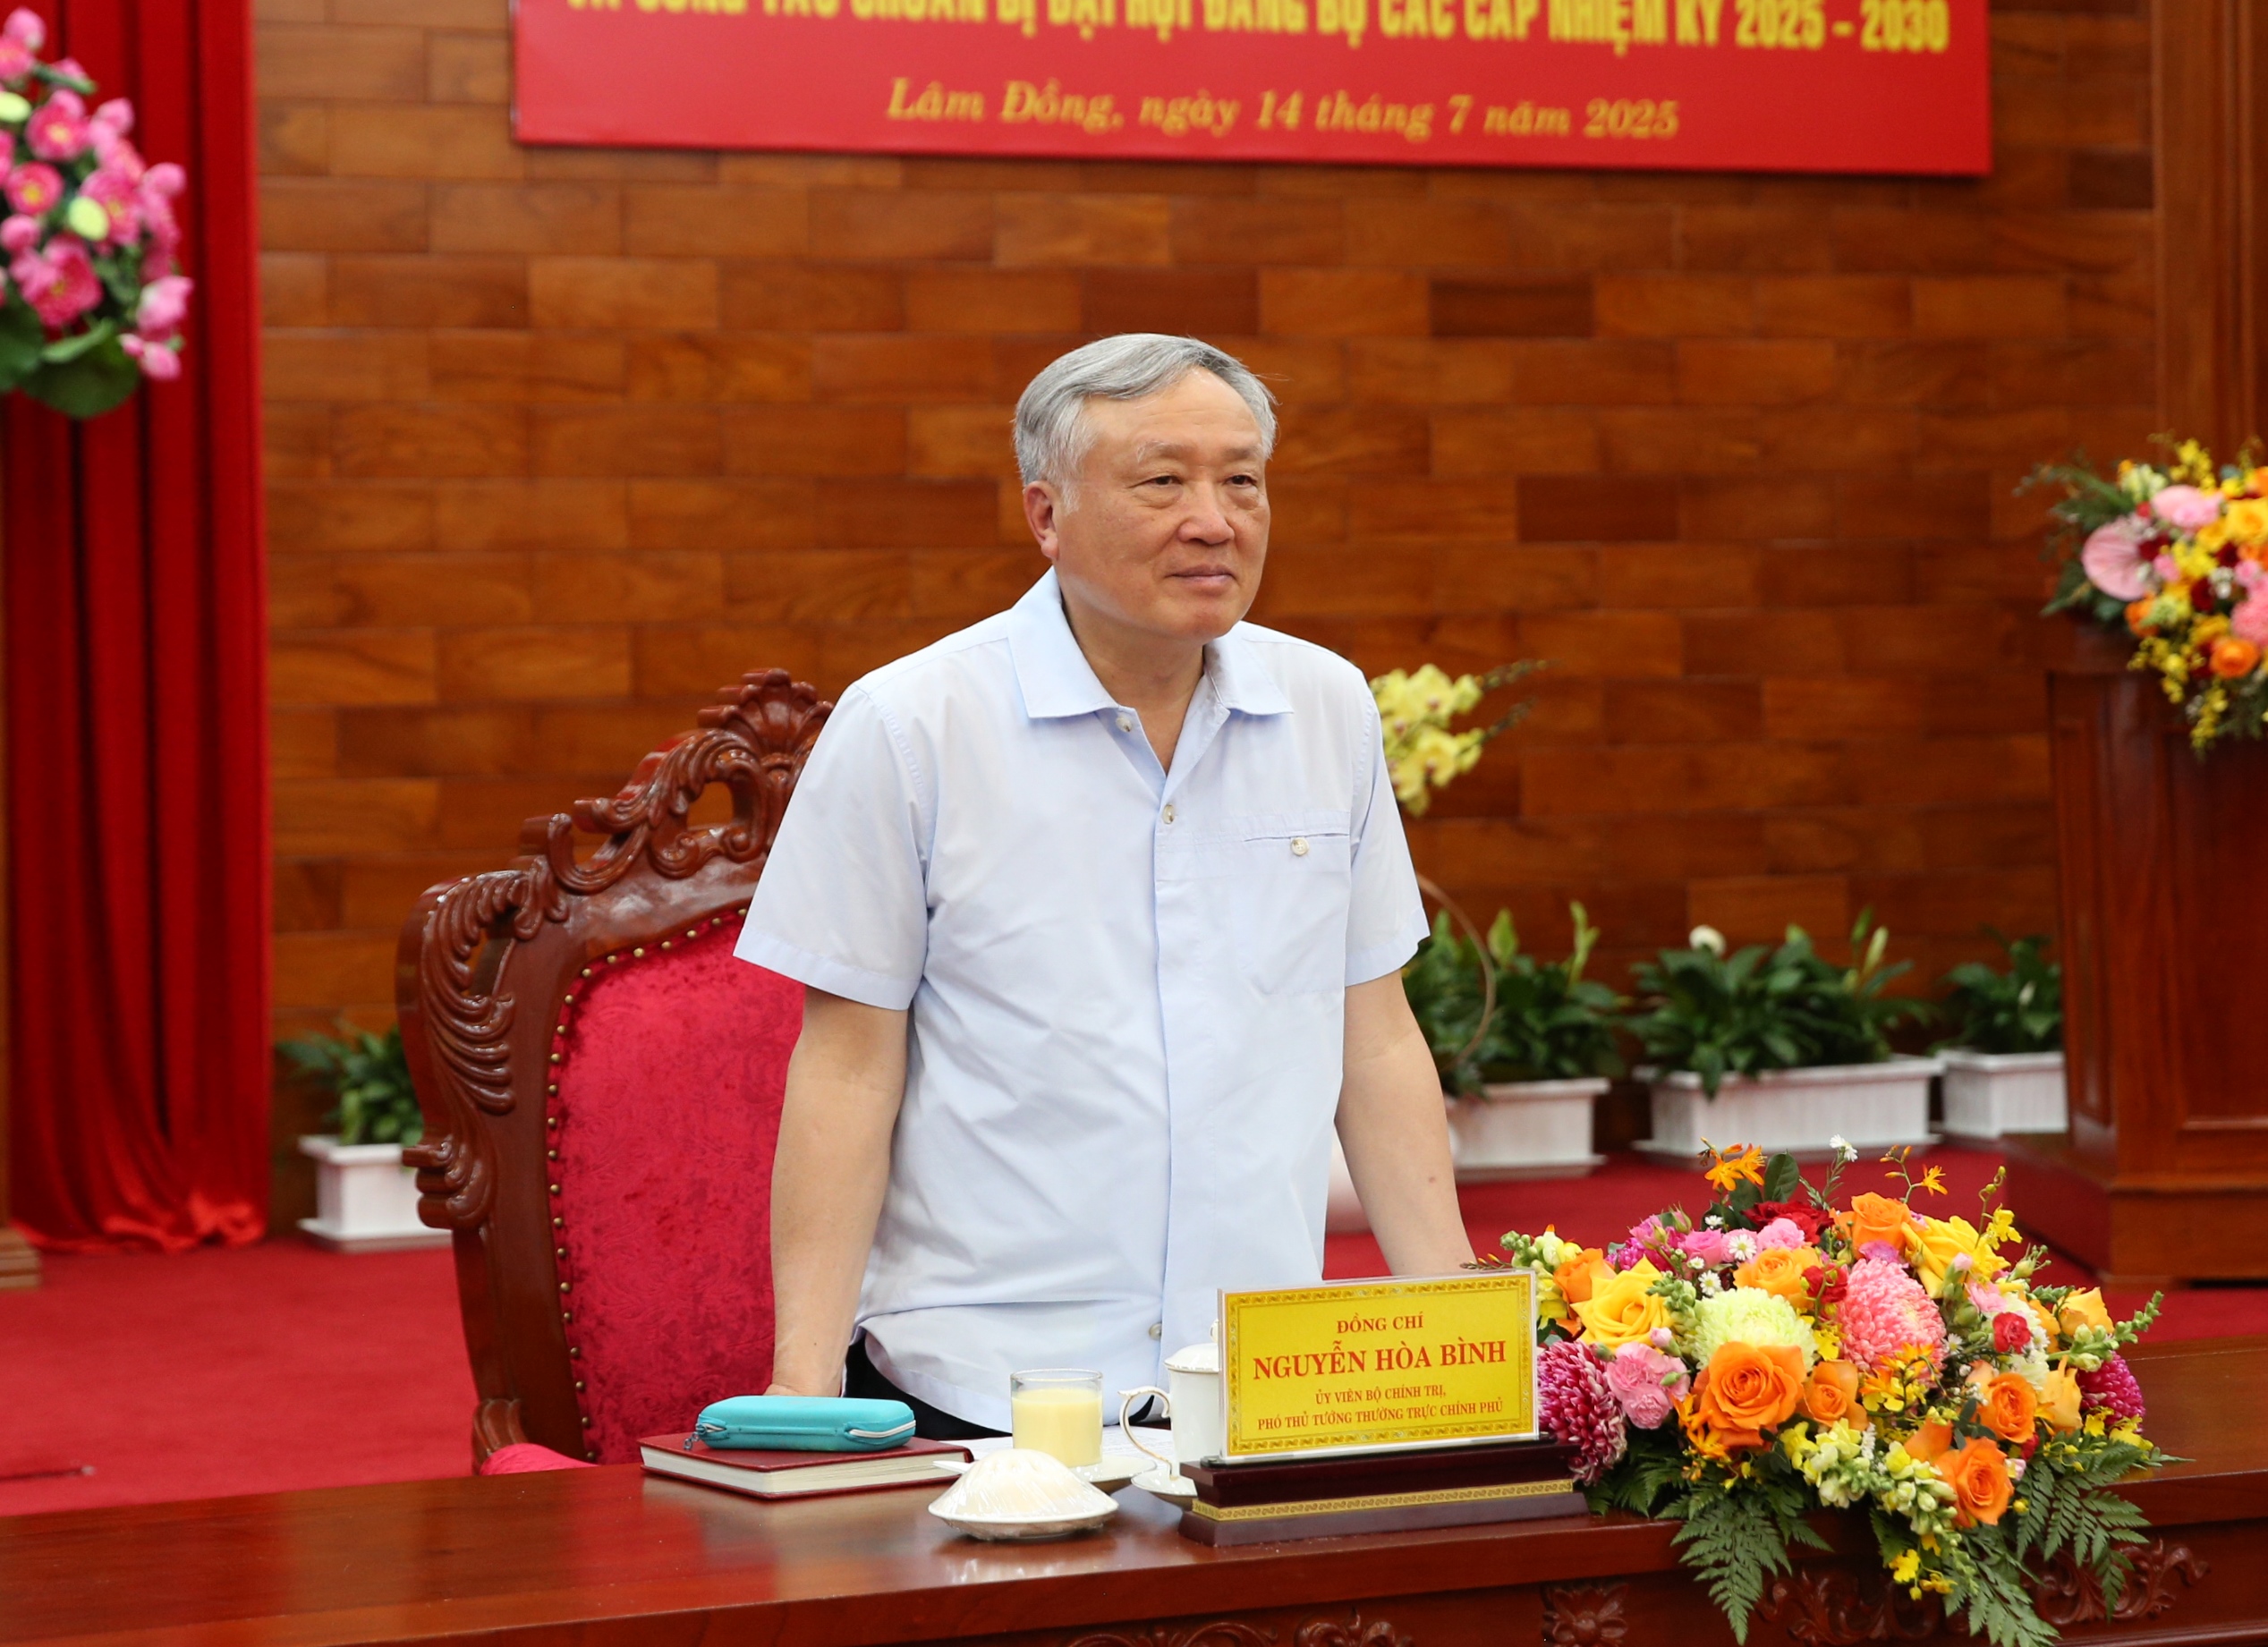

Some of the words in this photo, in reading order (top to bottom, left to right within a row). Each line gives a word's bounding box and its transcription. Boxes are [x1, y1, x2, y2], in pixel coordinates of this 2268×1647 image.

[1734, 0, 1827, 50] 2025
[1860, 0, 1950, 53] 2030
[886, 76, 985, 122] Lâm
[999, 76, 1124, 134] Đồng,
[1138, 88, 1240, 136] ngày
[1256, 89, 1304, 131] 14
[1314, 90, 1435, 142] tháng
[1447, 94, 1474, 134] 7
[1482, 100, 1572, 137] năm
[1582, 98, 1680, 140] 2025
[1337, 1312, 1387, 1334] ĐỒNG
[1392, 1311, 1423, 1330] CHÍ
[1253, 1339, 1367, 1380] NGUYỄN
[1374, 1340, 1432, 1371] HÒA
[1440, 1336, 1507, 1367] BÌNH
[1315, 1388, 1331, 1405] ỦY
[1334, 1388, 1363, 1404] VIÊN
[1365, 1386, 1382, 1404] BỘ
[1384, 1383, 1422, 1400] CHÍNH
[1423, 1384, 1447, 1398] TRỊ,
[1257, 1414, 1282, 1431] PHÓ
[1285, 1410, 1309, 1429] THỦ
[1312, 1409, 1353, 1426] TƯỚNG
[1355, 1405, 1404, 1423] THƯỜNG
[1406, 1403, 1437, 1421] TRỰC
[1440, 1400, 1476, 1417] CHÍNH
[1479, 1397, 1503, 1414] PHỦ
